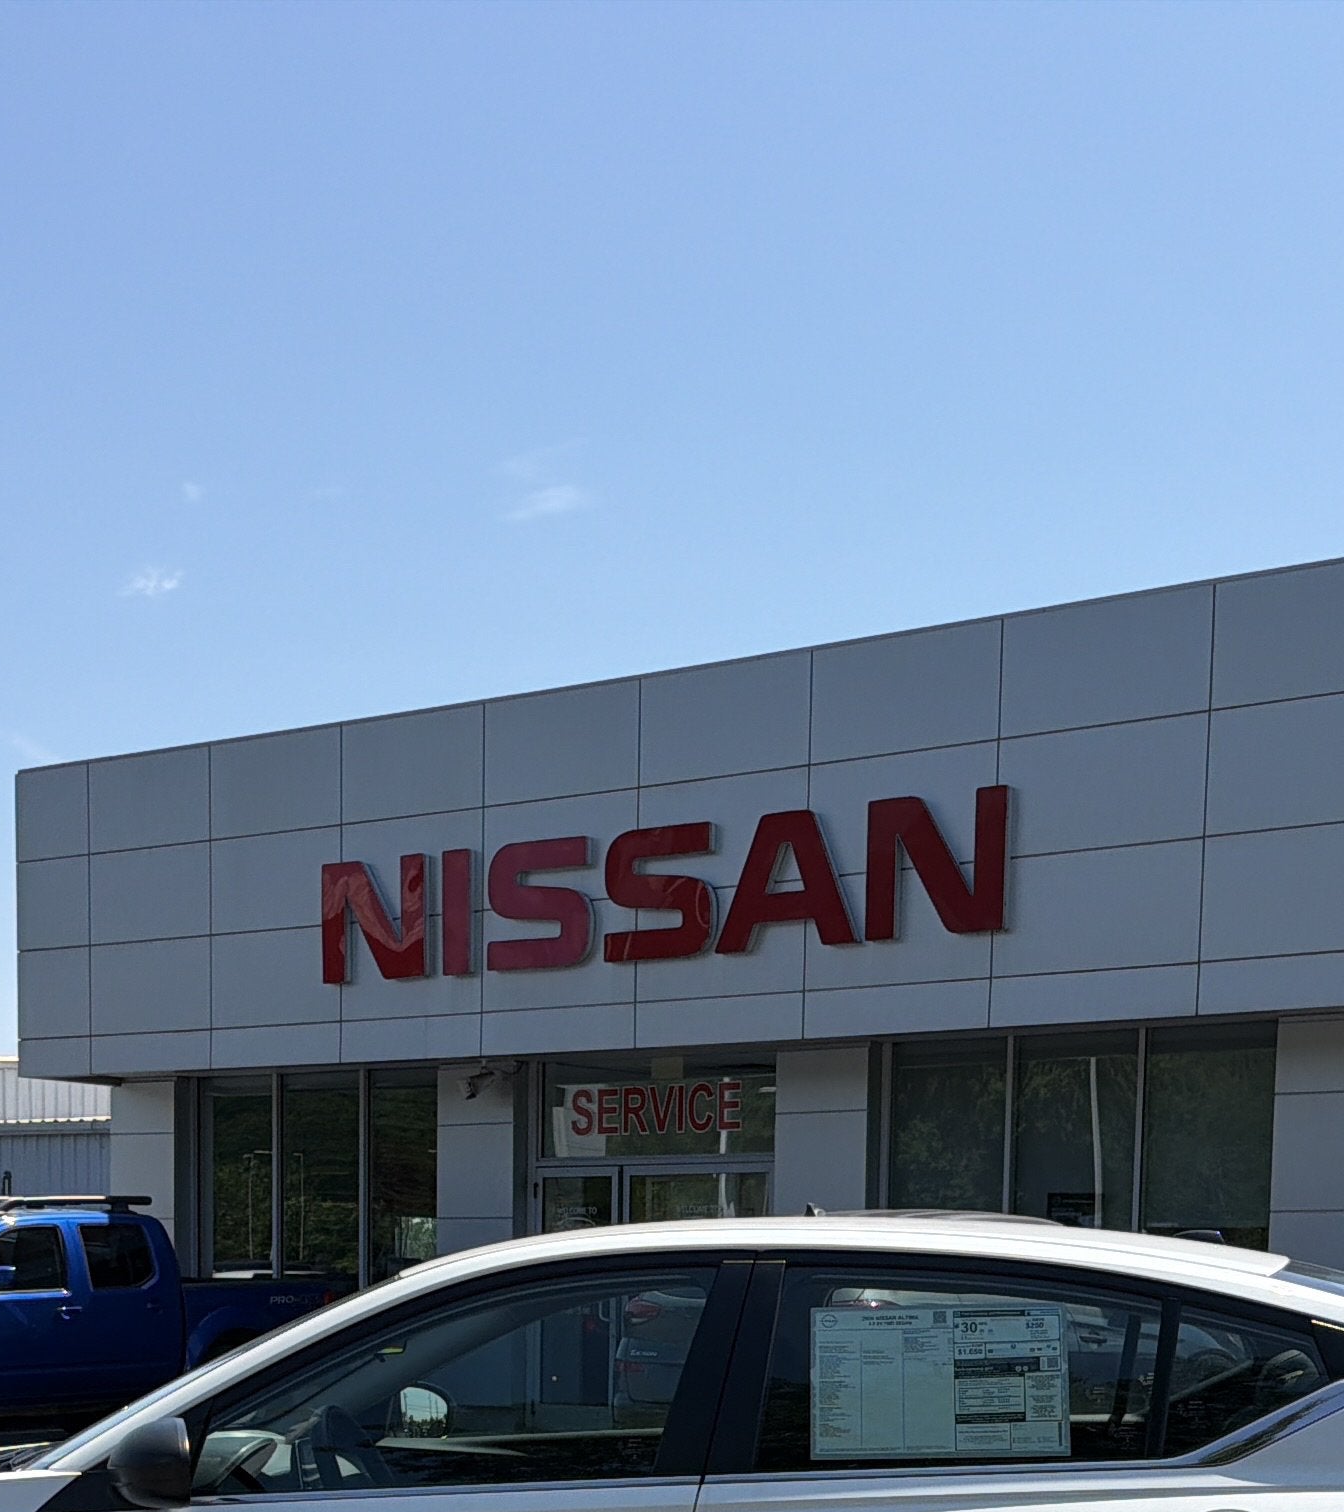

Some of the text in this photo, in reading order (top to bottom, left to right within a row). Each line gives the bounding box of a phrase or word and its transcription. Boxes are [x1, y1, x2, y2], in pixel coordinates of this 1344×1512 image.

[320, 785, 1012, 984] NISSAN
[570, 1080, 743, 1137] SERVICE
[960, 1321, 978, 1333] 30
